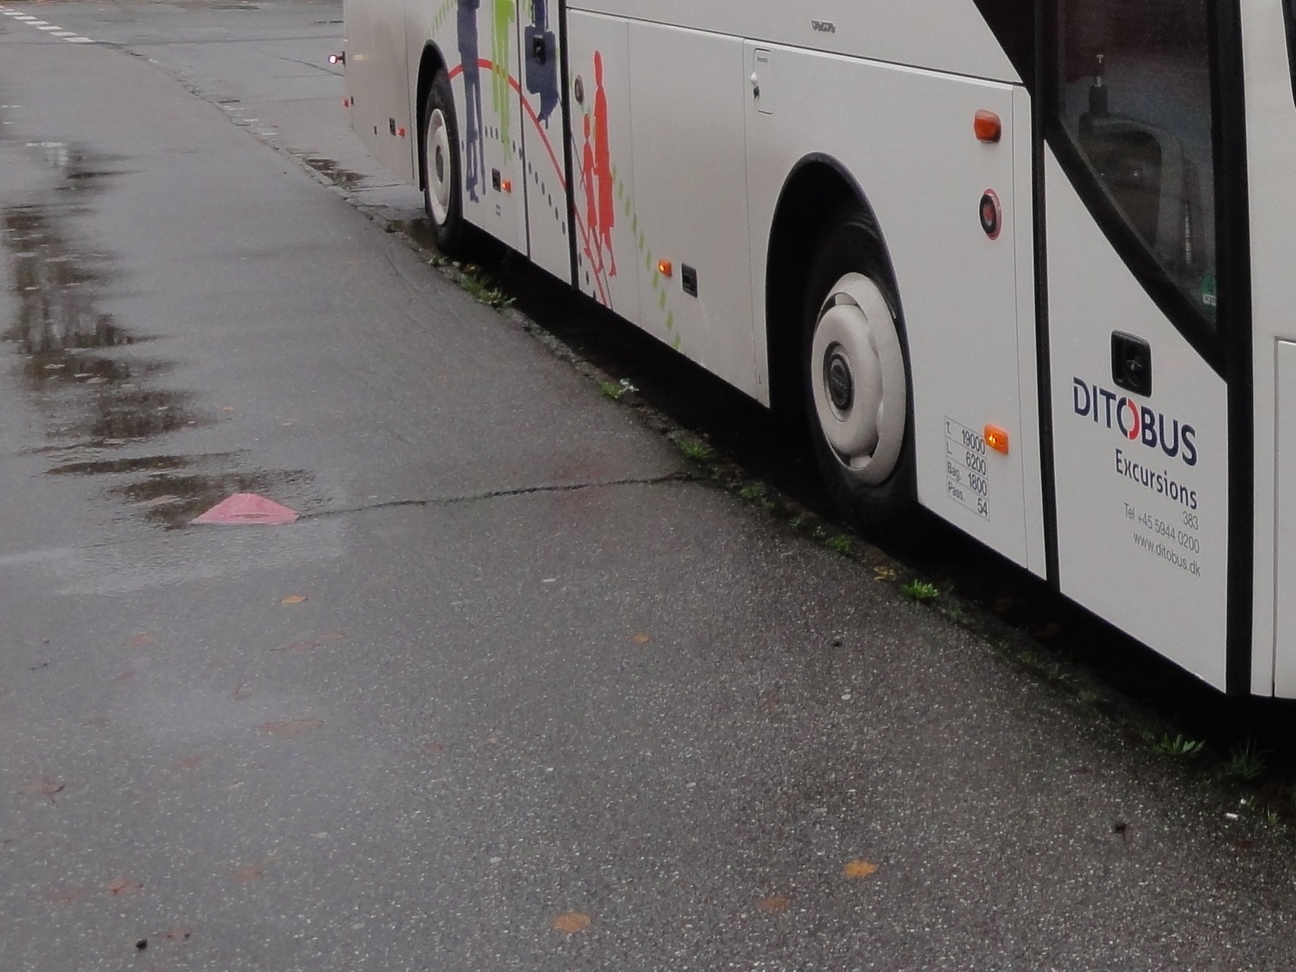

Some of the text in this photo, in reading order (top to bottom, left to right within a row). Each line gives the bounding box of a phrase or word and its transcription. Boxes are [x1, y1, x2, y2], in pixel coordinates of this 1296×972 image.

[1073, 376, 1198, 467] DITOBUS
[961, 429, 986, 456] 19000
[965, 451, 987, 476] 6200
[1115, 448, 1197, 510] Excursions
[968, 472, 987, 497] 1800
[977, 497, 988, 517] 54
[1123, 502, 1200, 554] Tel +45 5944 0200
[1133, 532, 1201, 578] www.ditobus.dk
